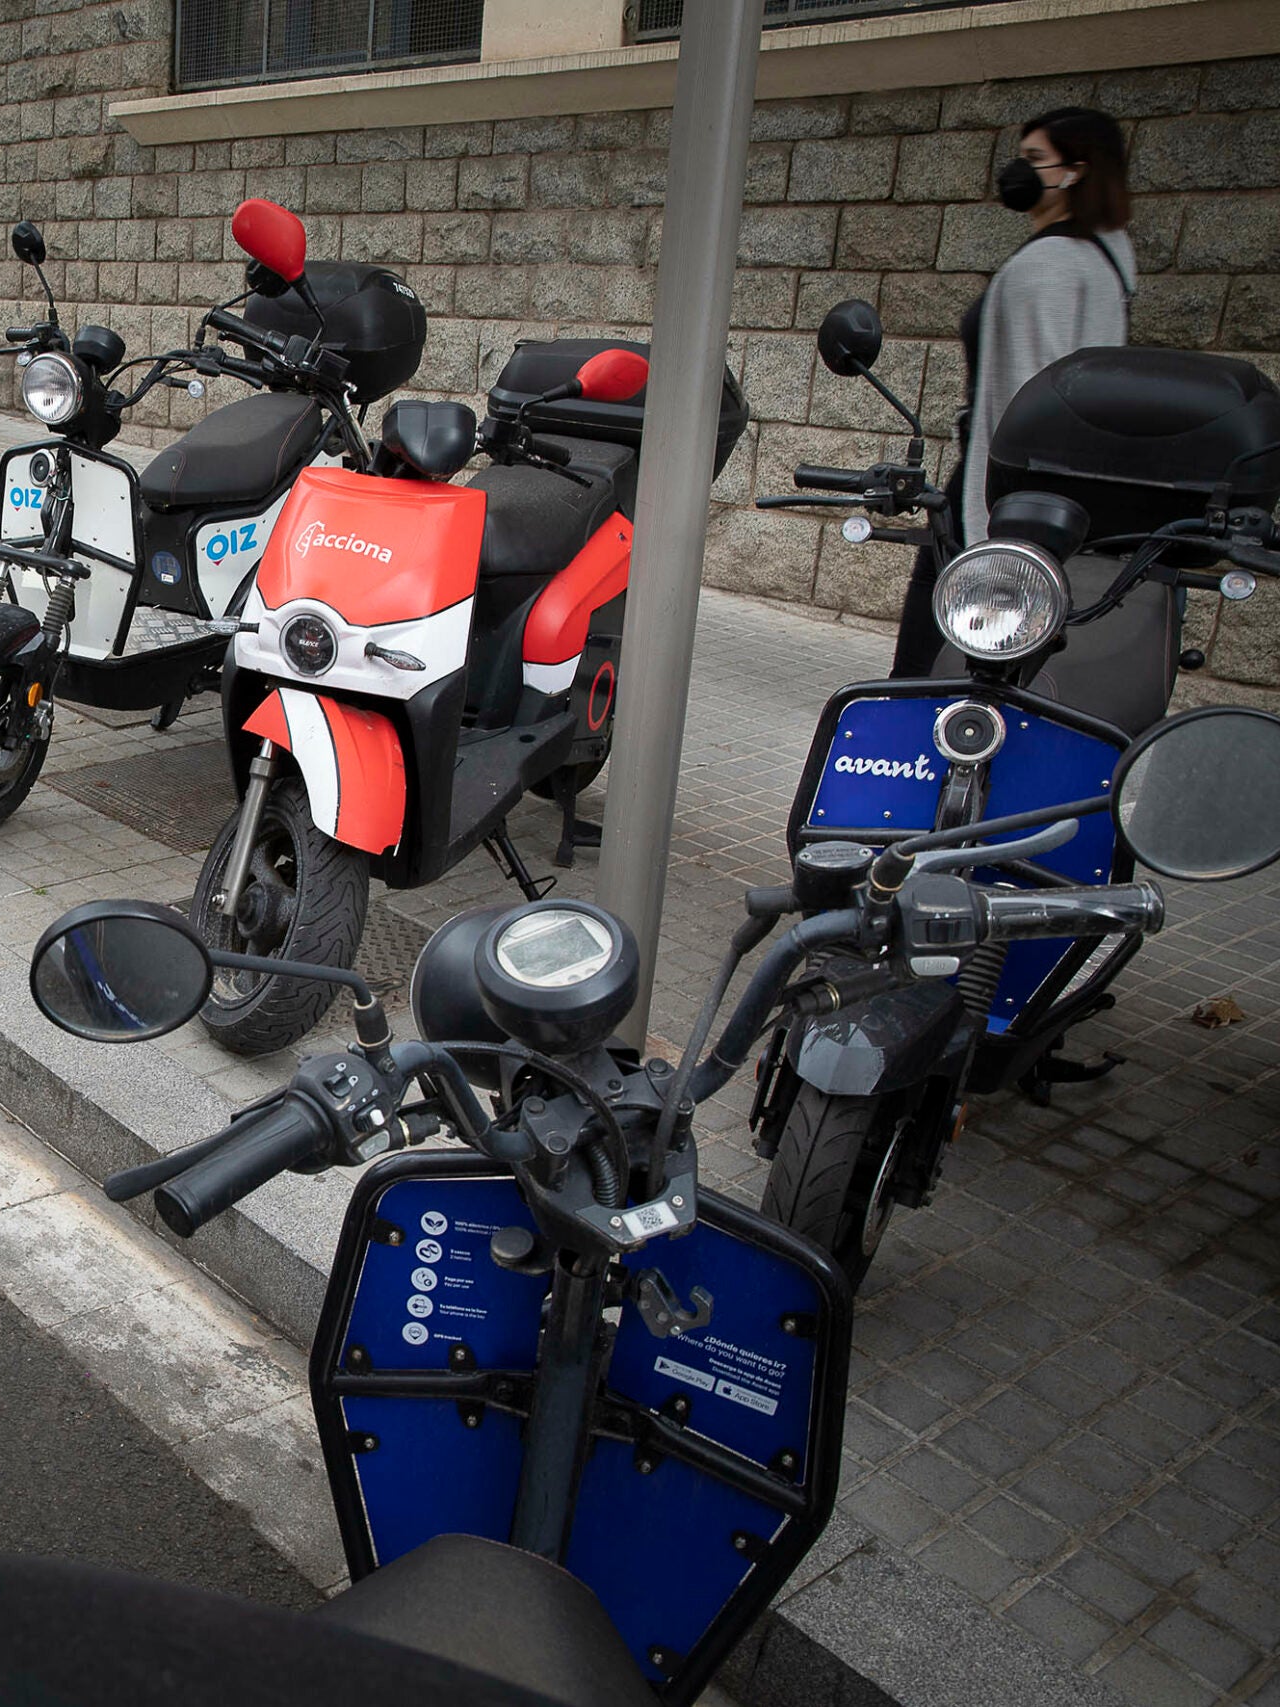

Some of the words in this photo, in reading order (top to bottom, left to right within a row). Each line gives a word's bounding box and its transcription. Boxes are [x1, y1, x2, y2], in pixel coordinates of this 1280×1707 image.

[10, 487, 42, 509] OIZ
[206, 523, 257, 560] OIZ
[313, 533, 393, 564] acciona
[835, 754, 936, 781] avant.
[677, 1334, 703, 1348] Where
[704, 1342, 717, 1353] do
[718, 1348, 734, 1360] you
[735, 1353, 757, 1368] want
[757, 1363, 767, 1373] to
[768, 1368, 786, 1380] go?
[704, 1336, 738, 1353] ¿Dónde
[739, 1348, 773, 1367] quieres
[773, 1360, 787, 1371] ir?
[671, 1367, 696, 1384] Google
[695, 1377, 709, 1389] Play
[740, 1374, 751, 1384] the
[734, 1391, 749, 1405] App
[749, 1399, 770, 1411] Store
